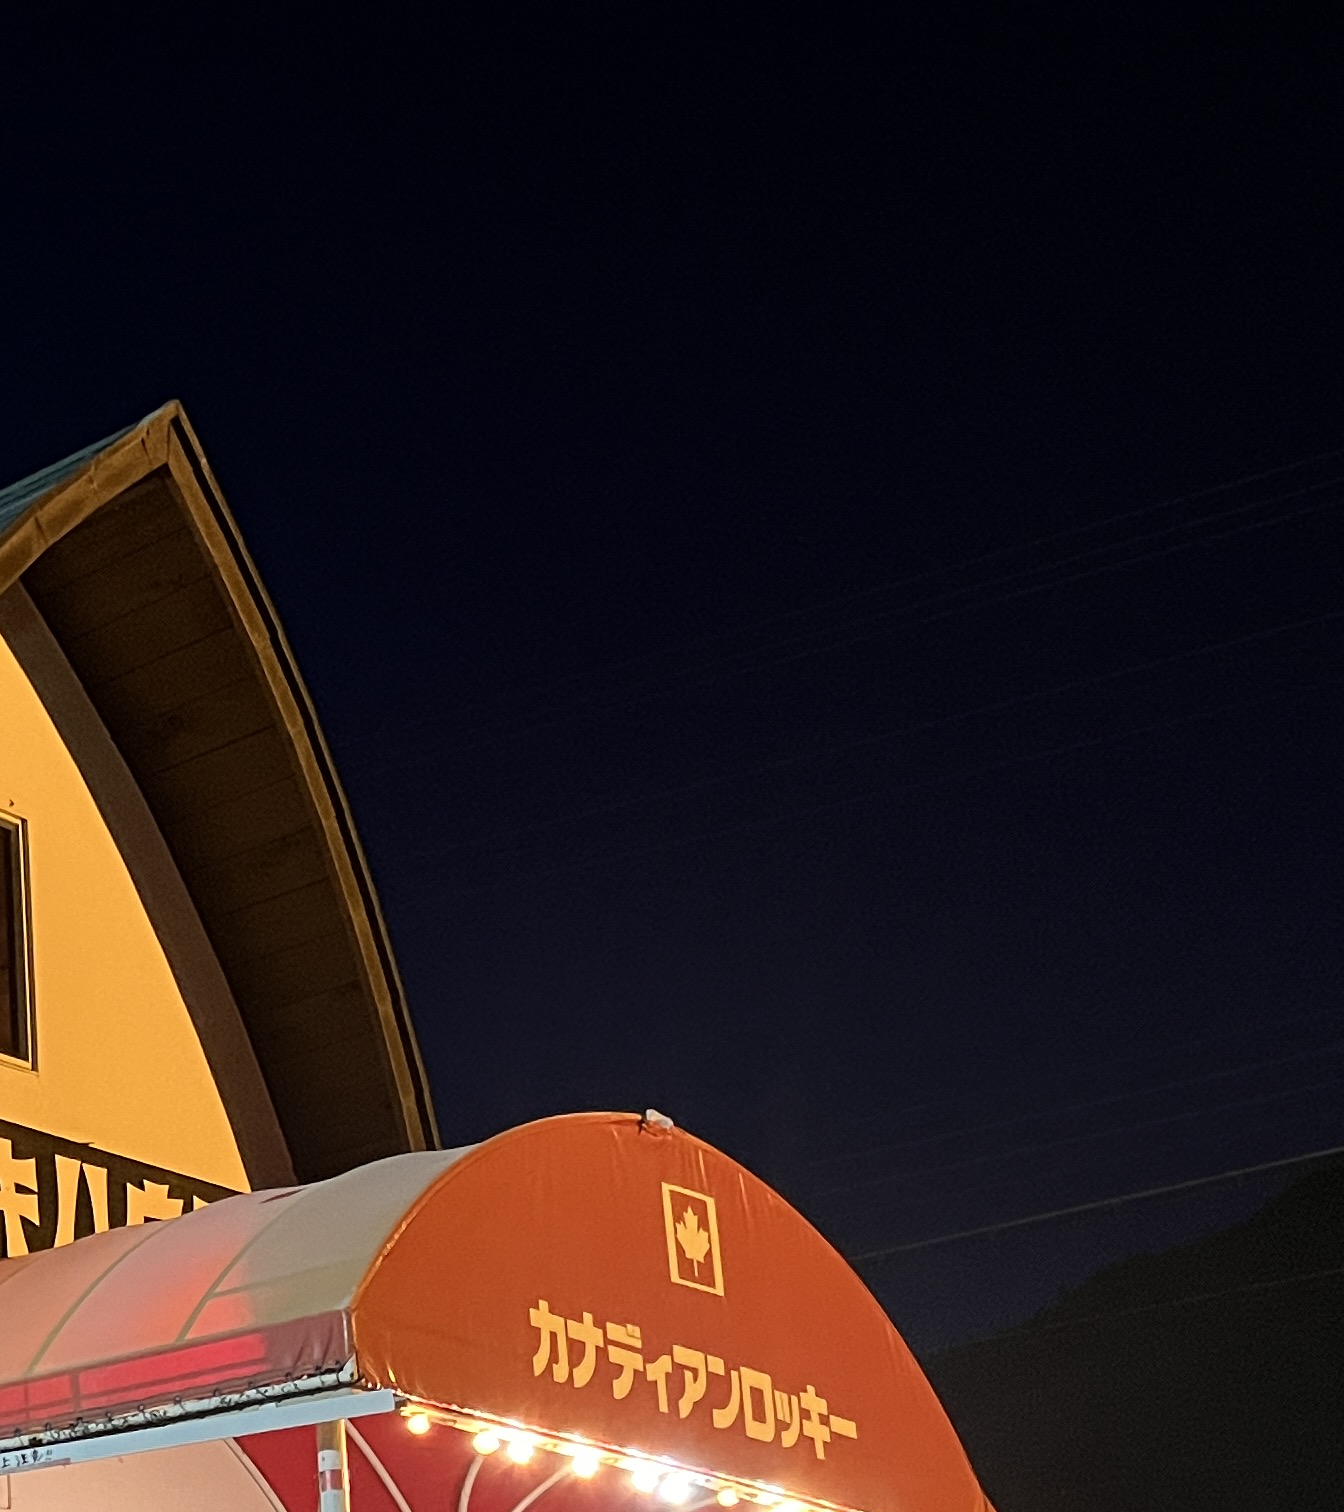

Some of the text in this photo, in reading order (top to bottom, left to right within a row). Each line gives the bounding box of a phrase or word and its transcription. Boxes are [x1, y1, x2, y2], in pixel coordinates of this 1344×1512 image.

[529, 1299, 857, 1460] カナディアンロッキー
